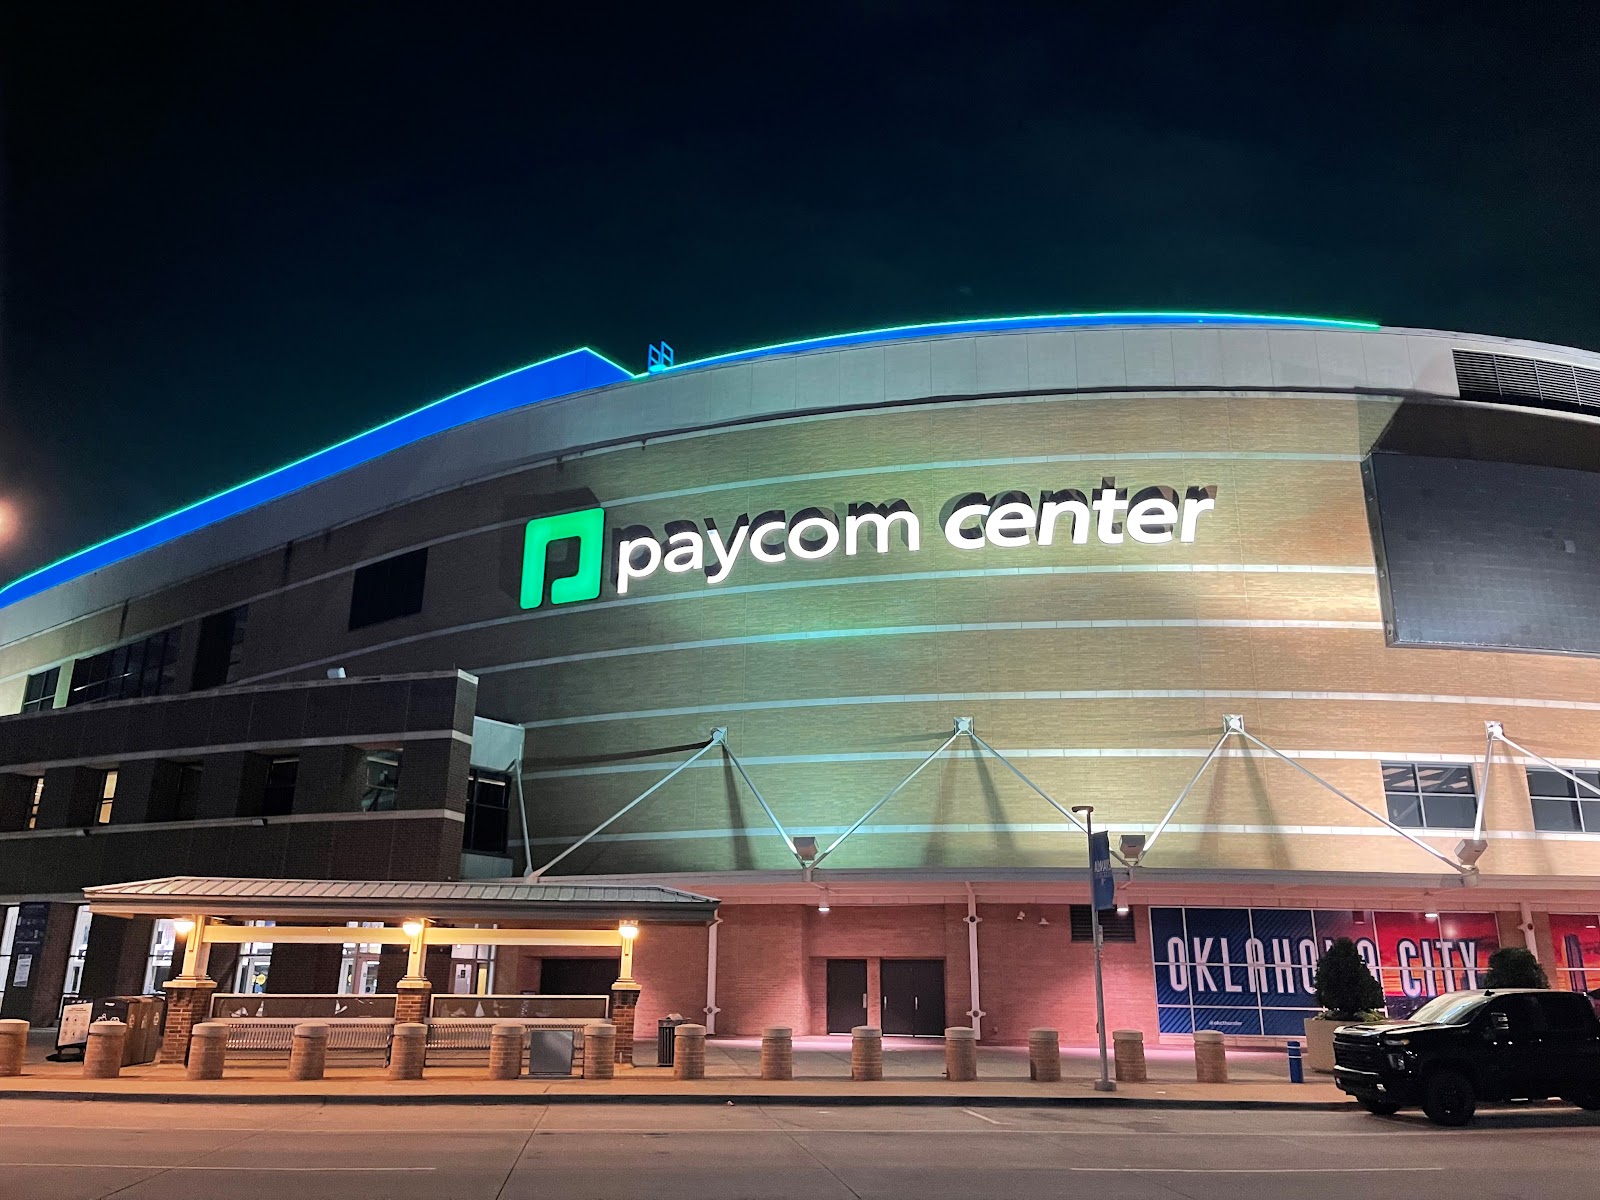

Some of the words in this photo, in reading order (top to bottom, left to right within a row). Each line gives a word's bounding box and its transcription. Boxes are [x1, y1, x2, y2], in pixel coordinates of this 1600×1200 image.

[617, 510, 920, 594] paycom
[945, 488, 1215, 550] center
[1167, 936, 1379, 995] OKLAHOA
[1399, 940, 1477, 997] CITY
